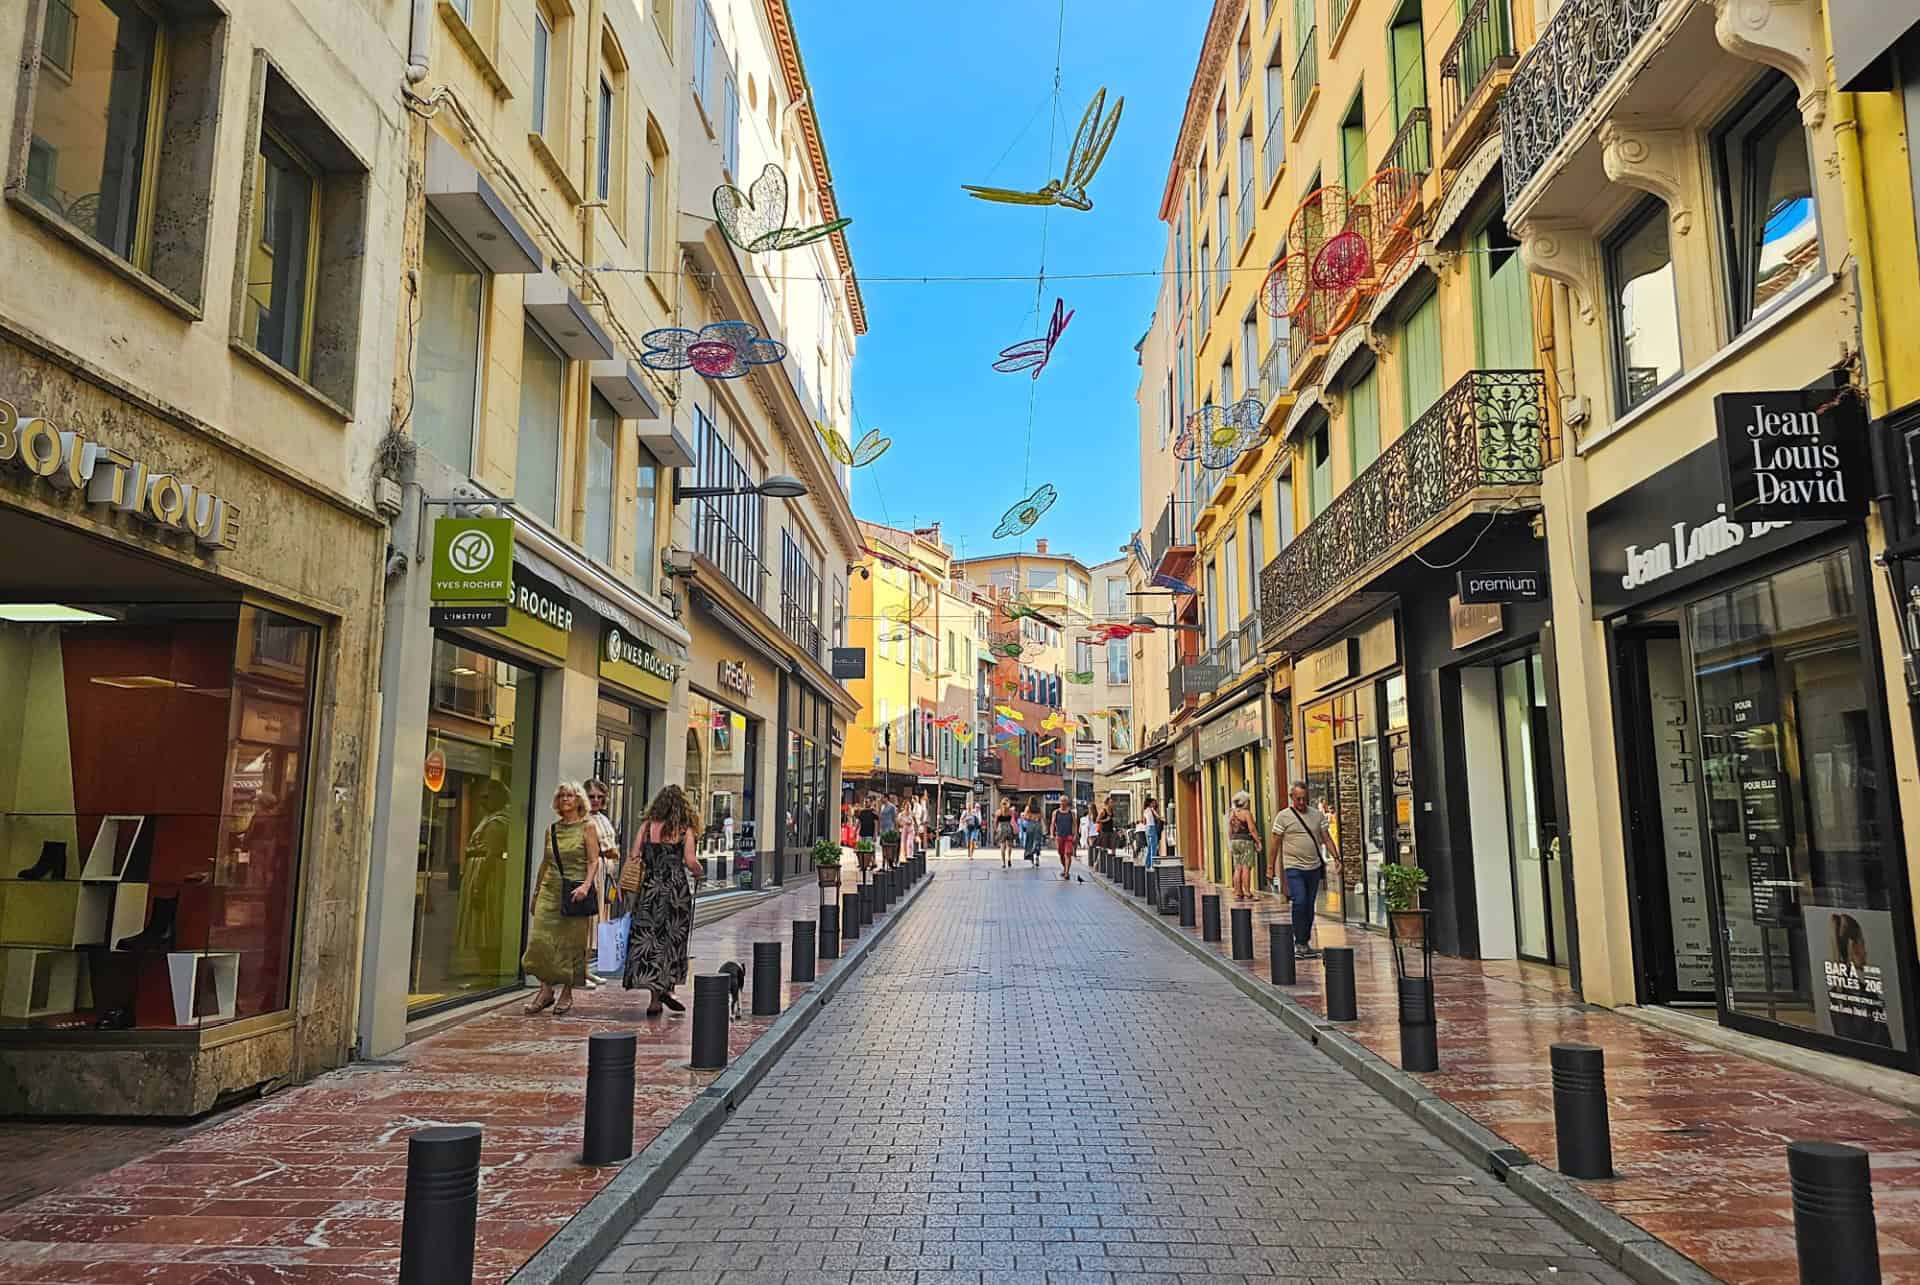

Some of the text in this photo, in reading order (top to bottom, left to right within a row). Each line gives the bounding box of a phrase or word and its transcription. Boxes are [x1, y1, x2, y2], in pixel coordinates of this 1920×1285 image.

[1746, 405, 1821, 437] Jean
[1748, 436, 1840, 470] Louis
[1752, 470, 1849, 505] David
[1622, 503, 1745, 590] Jean Louis
[436, 580, 503, 589] YVES ROCHER
[1469, 576, 1536, 594] premium
[444, 611, 493, 621] L'INSTITUT
[520, 586, 573, 632] ROCHER
[622, 640, 675, 682] YVES ROCHER
[1734, 700, 1752, 710] POUR
[1744, 779, 1777, 790] POUR ELLE
[1824, 961, 1848, 977] BAR
[1826, 975, 1861, 990] STYLES
